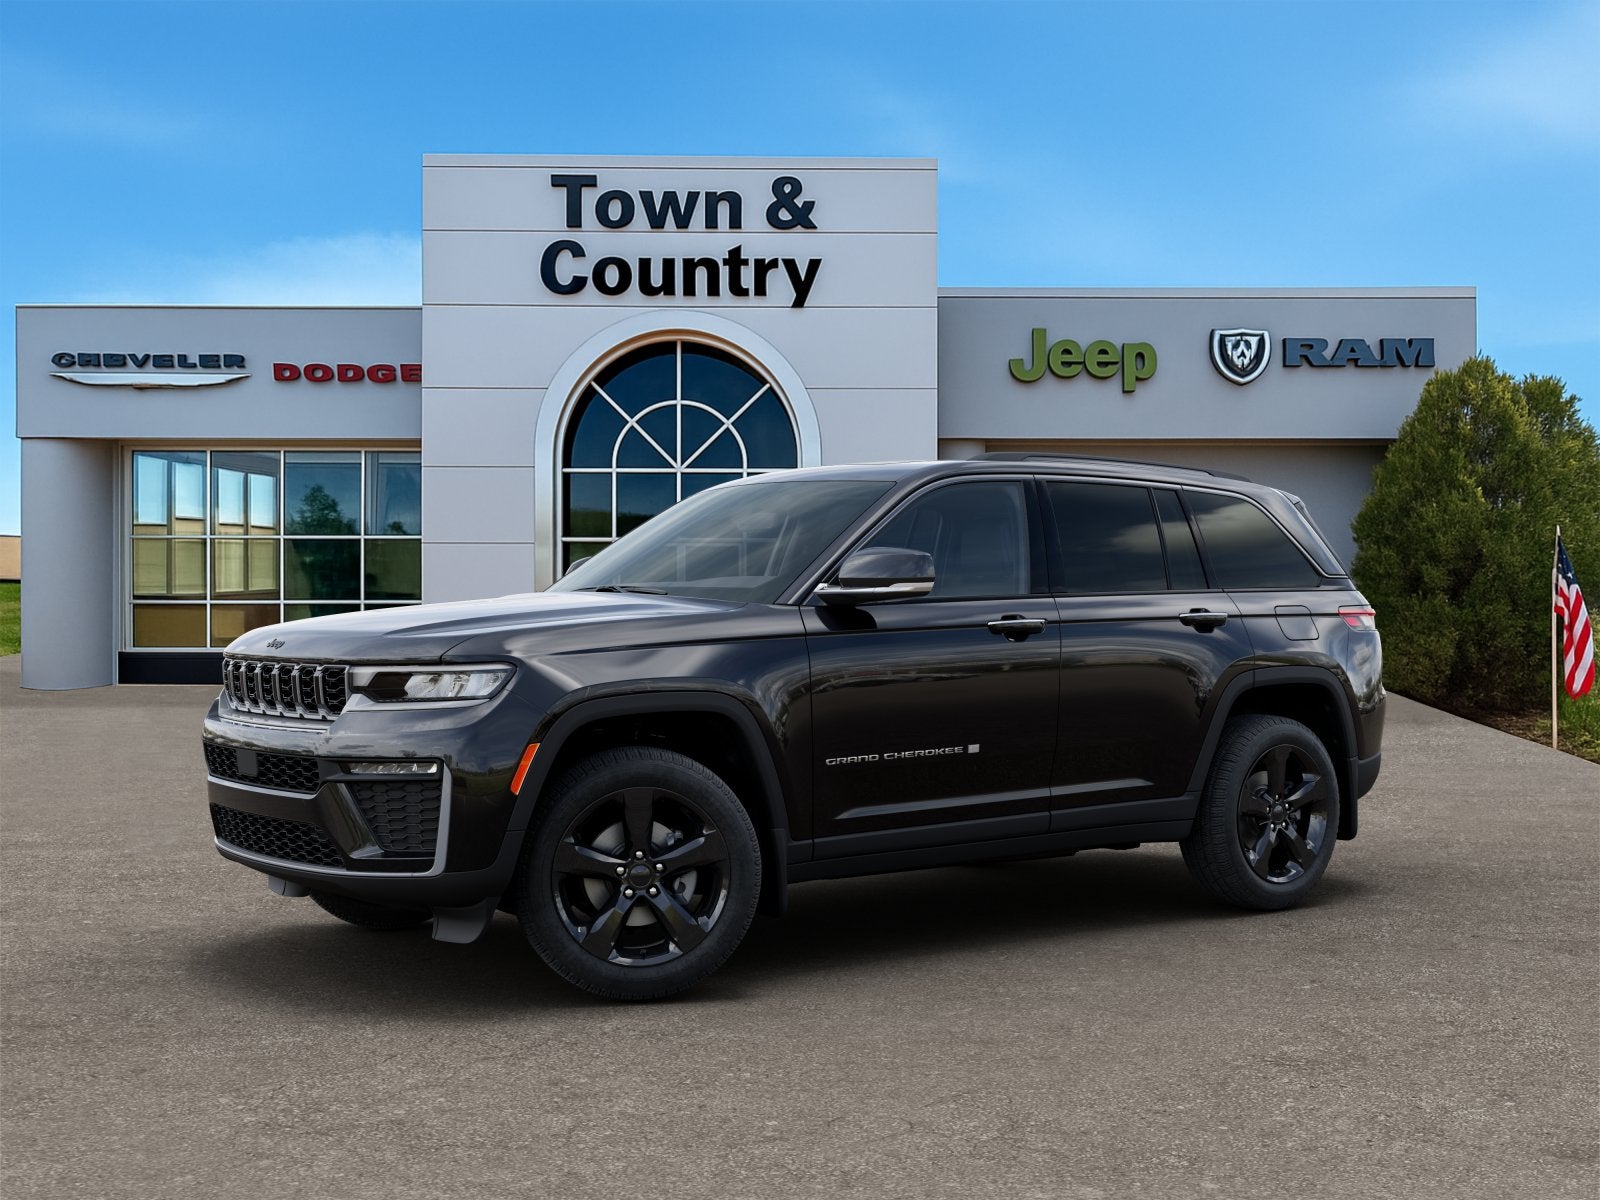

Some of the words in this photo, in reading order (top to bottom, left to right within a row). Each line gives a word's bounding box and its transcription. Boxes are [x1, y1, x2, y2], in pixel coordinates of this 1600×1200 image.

[550, 173, 743, 229] Town
[765, 175, 818, 230] &
[540, 239, 823, 308] Country
[273, 362, 422, 383] DODGE
[1009, 327, 1158, 392] Jeep
[1282, 337, 1436, 368] RAM
[825, 754, 880, 766] GRAND
[883, 746, 965, 760] CHEROKEE
